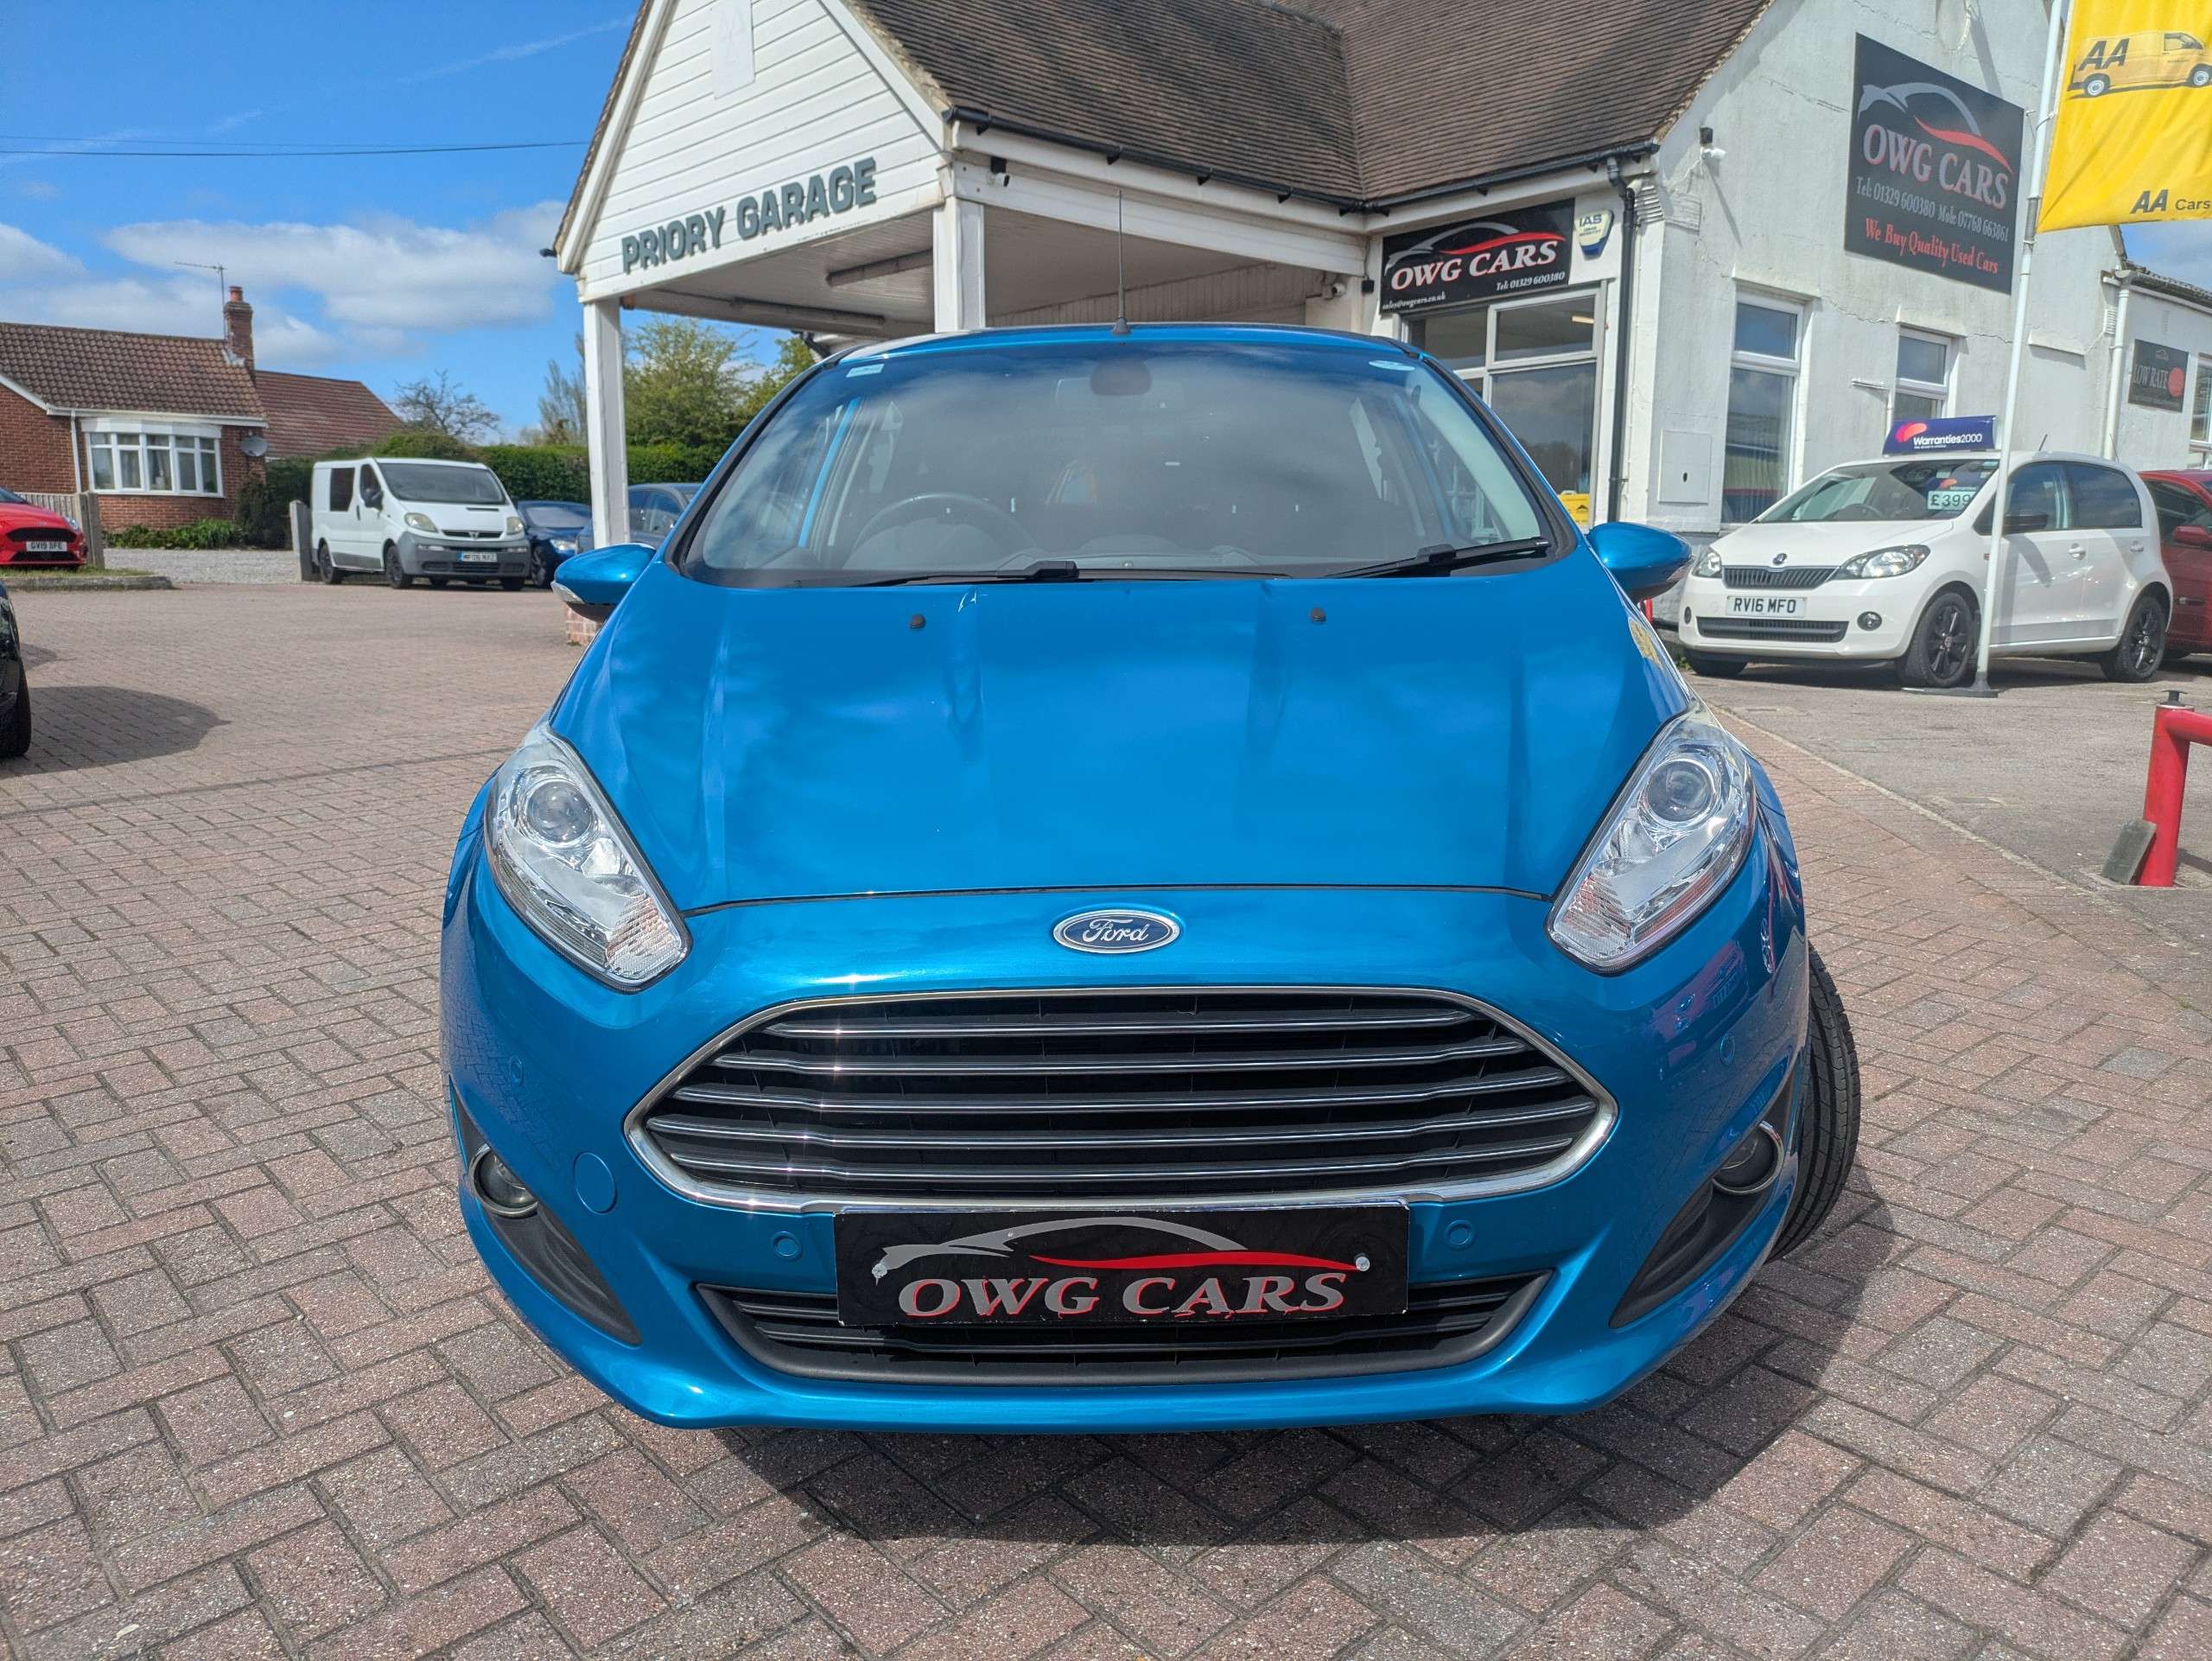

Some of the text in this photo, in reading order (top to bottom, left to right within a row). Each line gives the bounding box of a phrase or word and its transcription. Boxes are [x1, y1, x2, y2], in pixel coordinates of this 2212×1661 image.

[2077, 38, 2130, 71] AA
[1863, 124, 2009, 209] OWG CARS
[621, 156, 877, 275] PRIORY GARAGE
[1856, 176, 1872, 198] Tel:
[1873, 182, 1899, 207] 01329
[1901, 192, 1936, 219] 600380
[2131, 189, 2211, 214] AA Cars
[1866, 217, 1999, 274] We Buy Quality Used Cars
[1391, 241, 1558, 290] OWG CARS
[1510, 277, 1533, 289] 01329
[1533, 271, 1566, 285] 600380
[1913, 433, 1983, 446] Warranties2000
[1733, 597, 1796, 614] RV16 MFO
[1083, 918, 1150, 943] Ford
[898, 1271, 1346, 1320] OWG CARS
